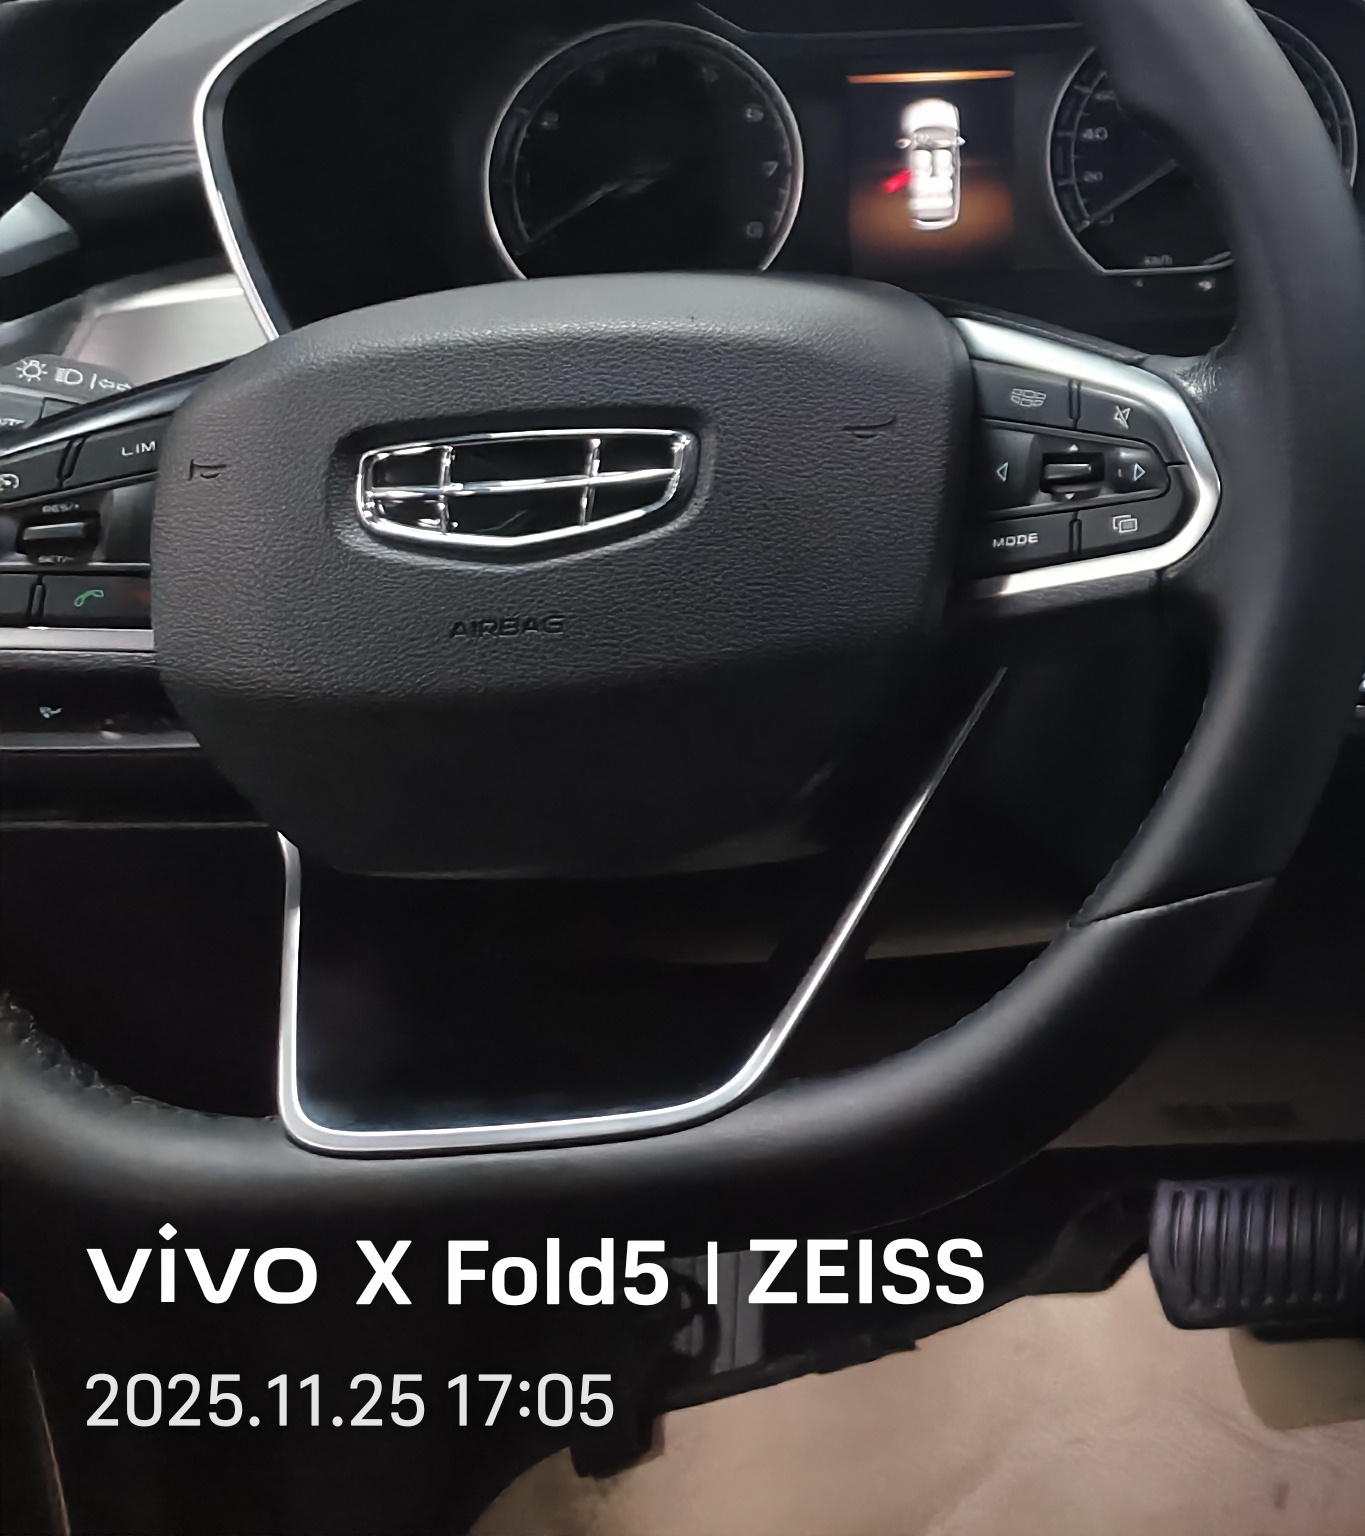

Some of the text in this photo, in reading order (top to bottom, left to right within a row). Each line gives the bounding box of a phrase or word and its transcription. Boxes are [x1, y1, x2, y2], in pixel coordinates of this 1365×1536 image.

[121, 440, 157, 457] LIM
[992, 532, 1039, 549] MODE
[449, 613, 566, 640] AIRBAG
